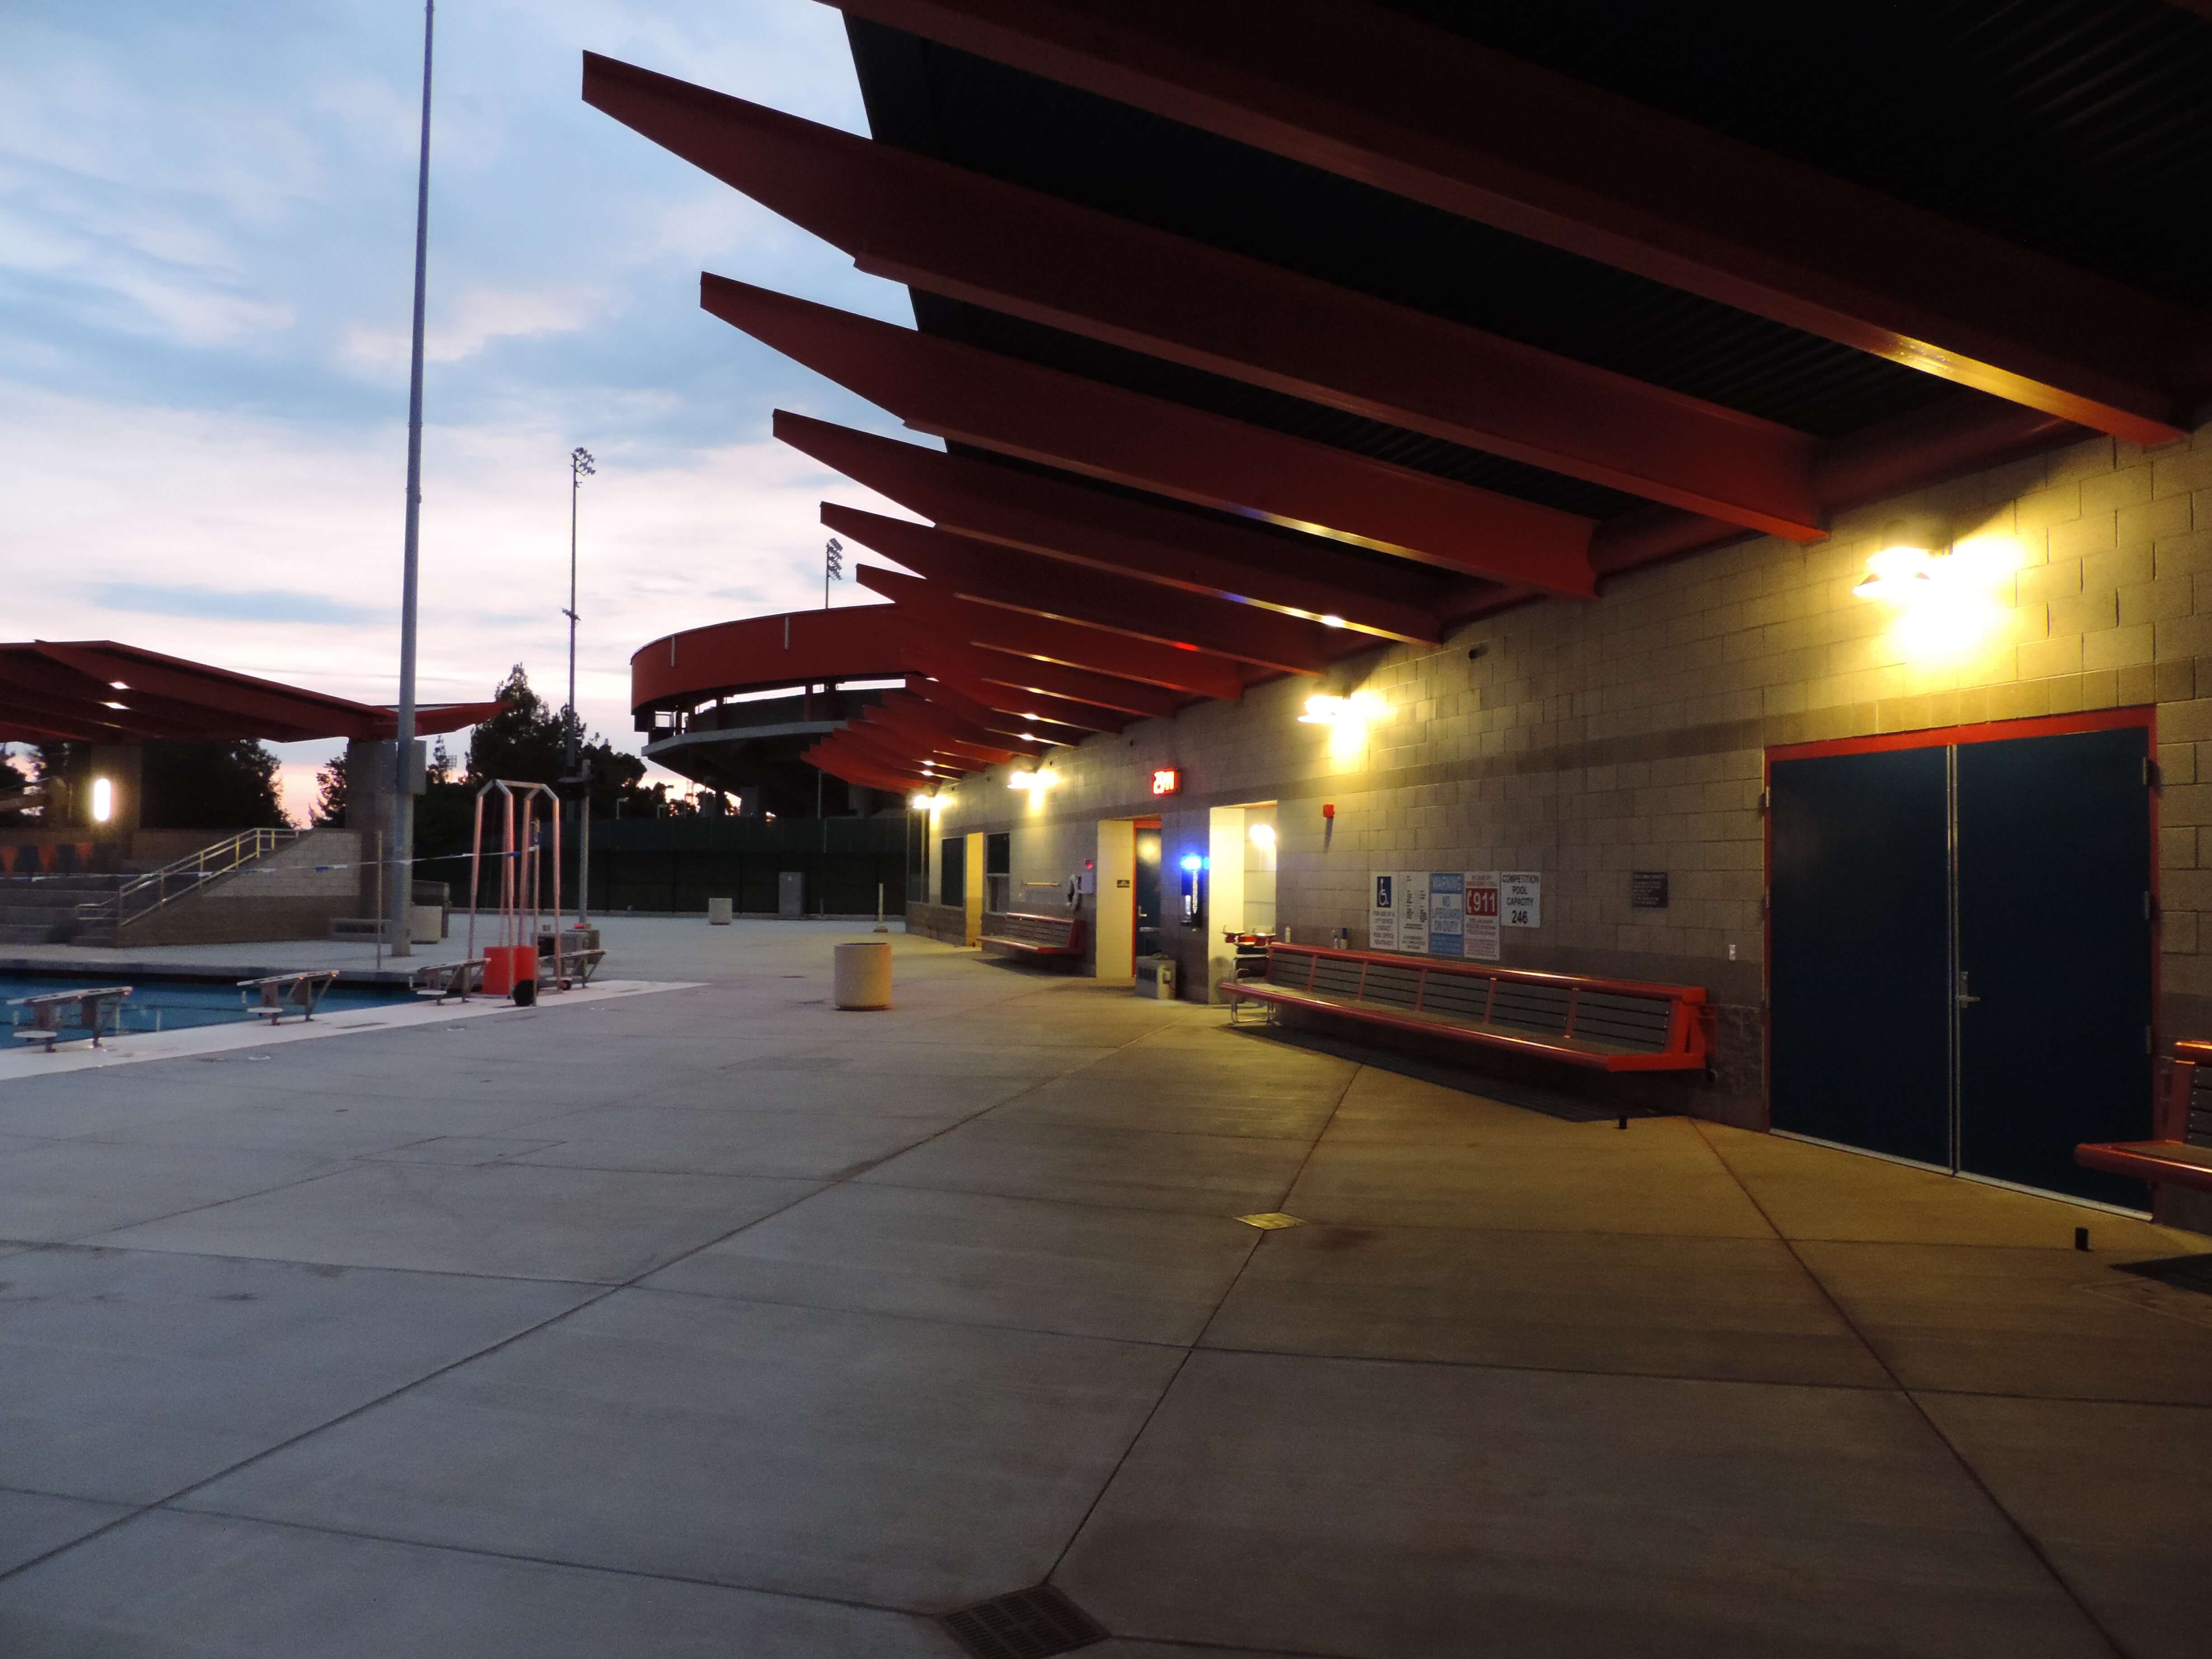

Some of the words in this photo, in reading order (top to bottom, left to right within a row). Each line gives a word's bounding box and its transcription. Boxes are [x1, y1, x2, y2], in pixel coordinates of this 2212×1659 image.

[1432, 876, 1461, 890] WARNING
[1502, 875, 1539, 883] COMPETITION
[1512, 886, 1527, 894] POOL
[1473, 892, 1495, 912] 911
[1507, 897, 1534, 906] CAPACITY
[1512, 910, 1528, 924] 246
